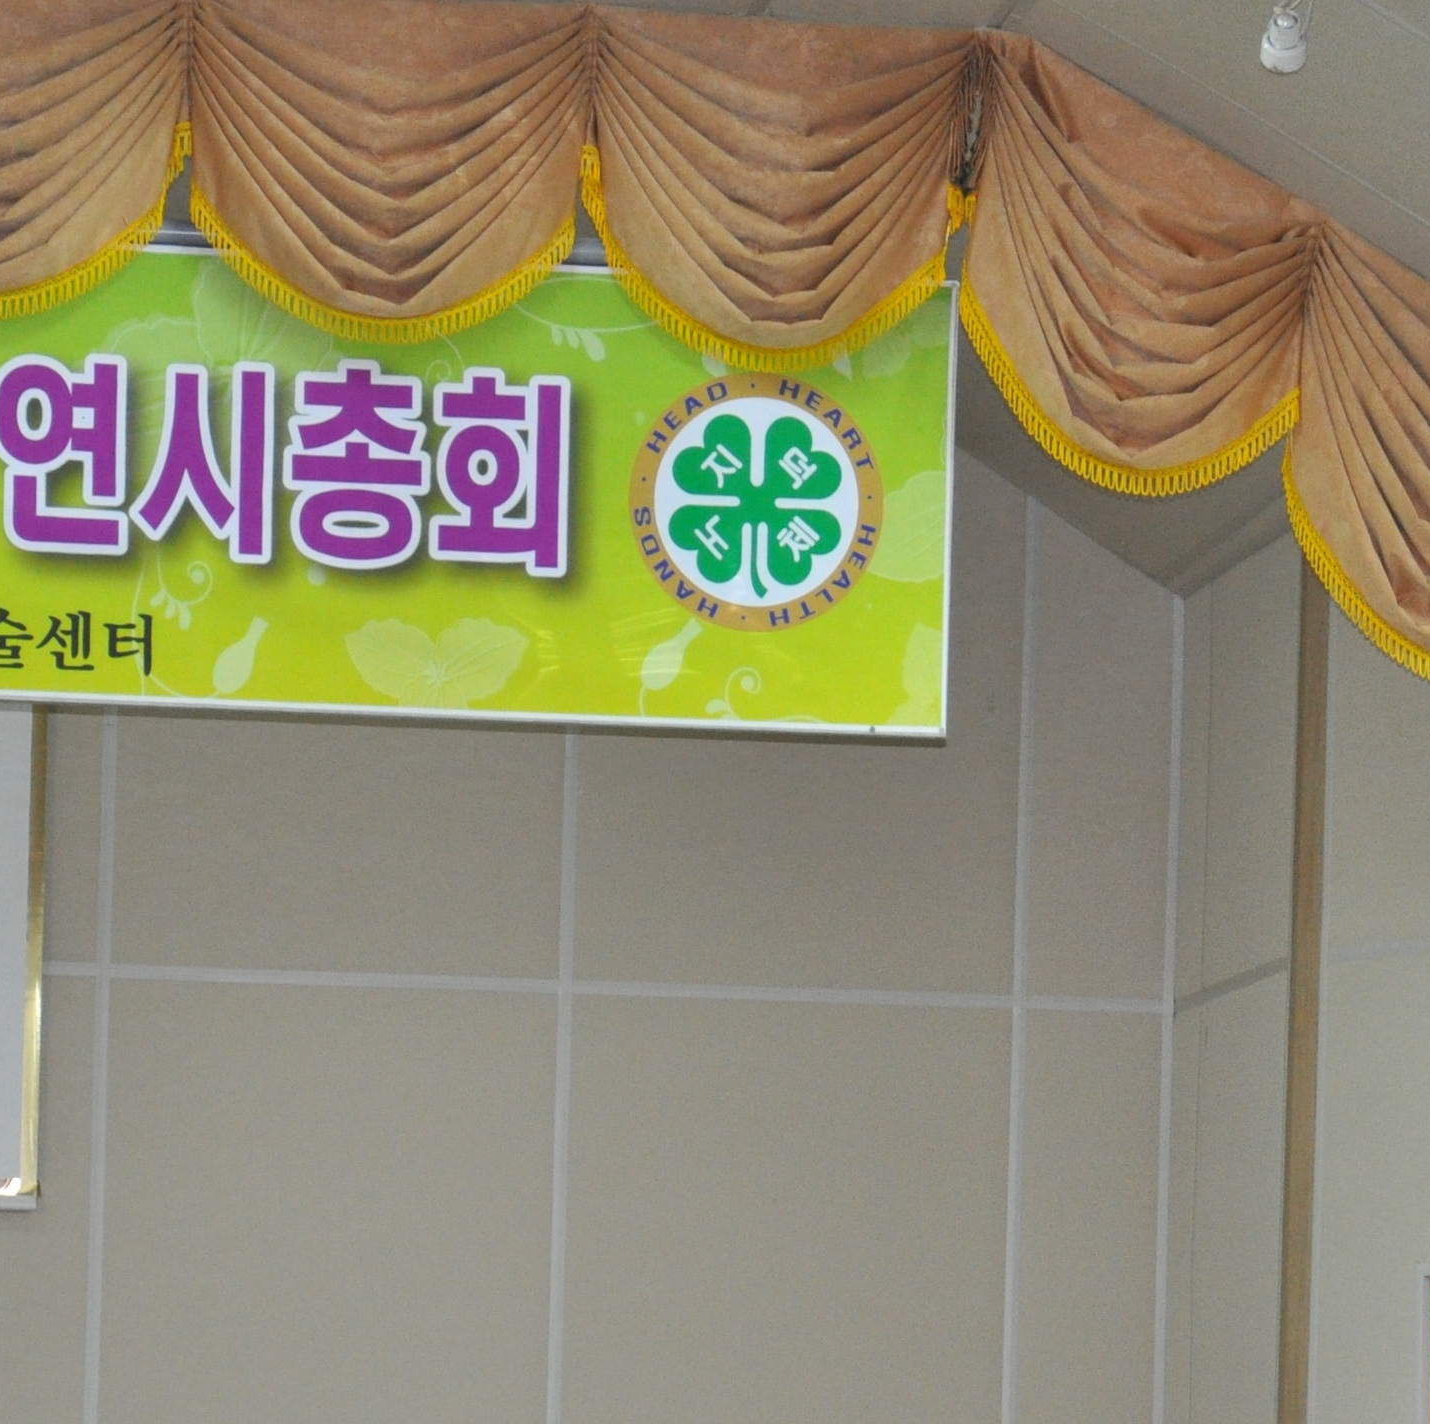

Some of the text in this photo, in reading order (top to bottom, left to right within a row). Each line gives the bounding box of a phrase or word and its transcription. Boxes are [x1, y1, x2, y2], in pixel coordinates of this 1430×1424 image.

[645, 382, 728, 454] HEAD
[778, 379, 874, 471] HEART
[634, 506, 719, 619] HANDS
[768, 523, 877, 627] HEALTH
